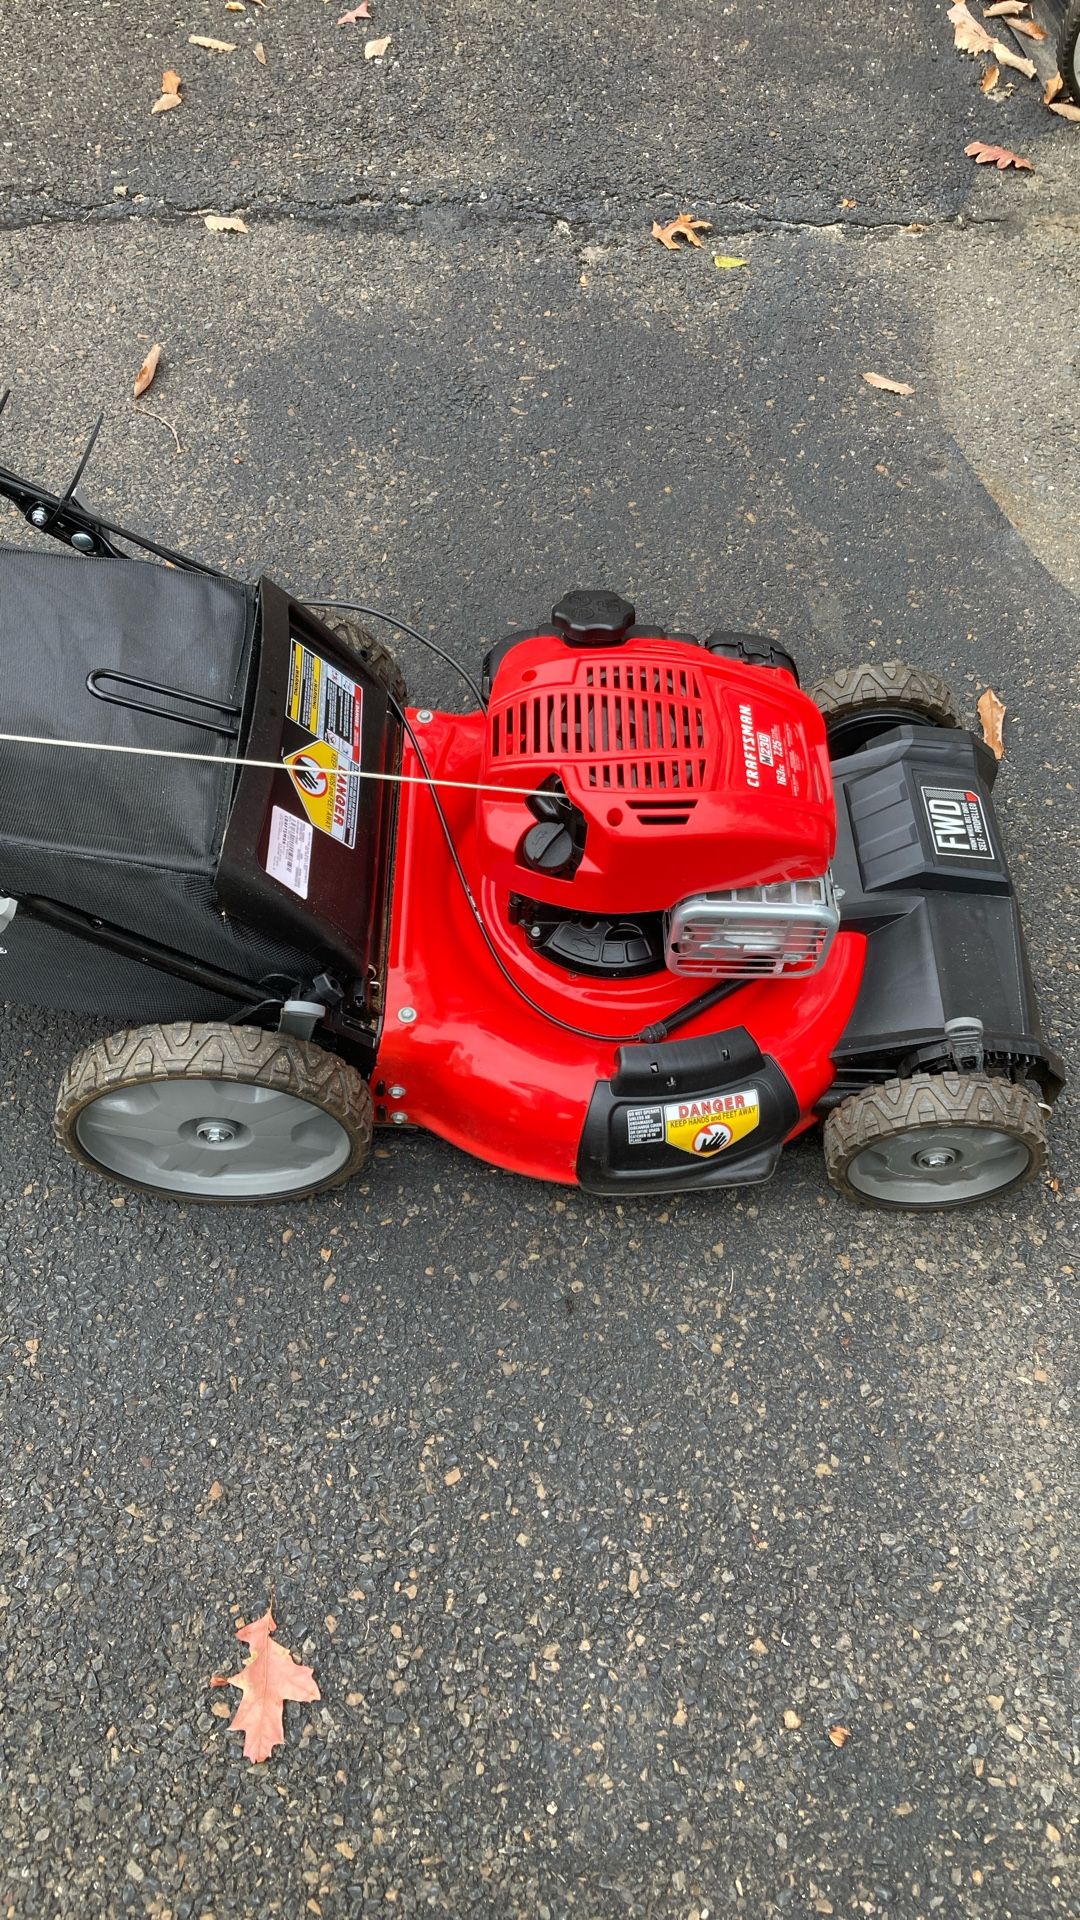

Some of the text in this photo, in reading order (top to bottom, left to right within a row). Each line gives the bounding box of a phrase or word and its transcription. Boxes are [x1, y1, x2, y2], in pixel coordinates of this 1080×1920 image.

[739, 705, 760, 788] CRAFTSMAN
[928, 799, 971, 850] FWD
[670, 1119, 687, 1129] KEEP
[688, 1115, 710, 1126] HANDS
[722, 1111, 737, 1121] FEET
[738, 1107, 756, 1117] AWAY
[678, 1094, 746, 1119] DANGER
